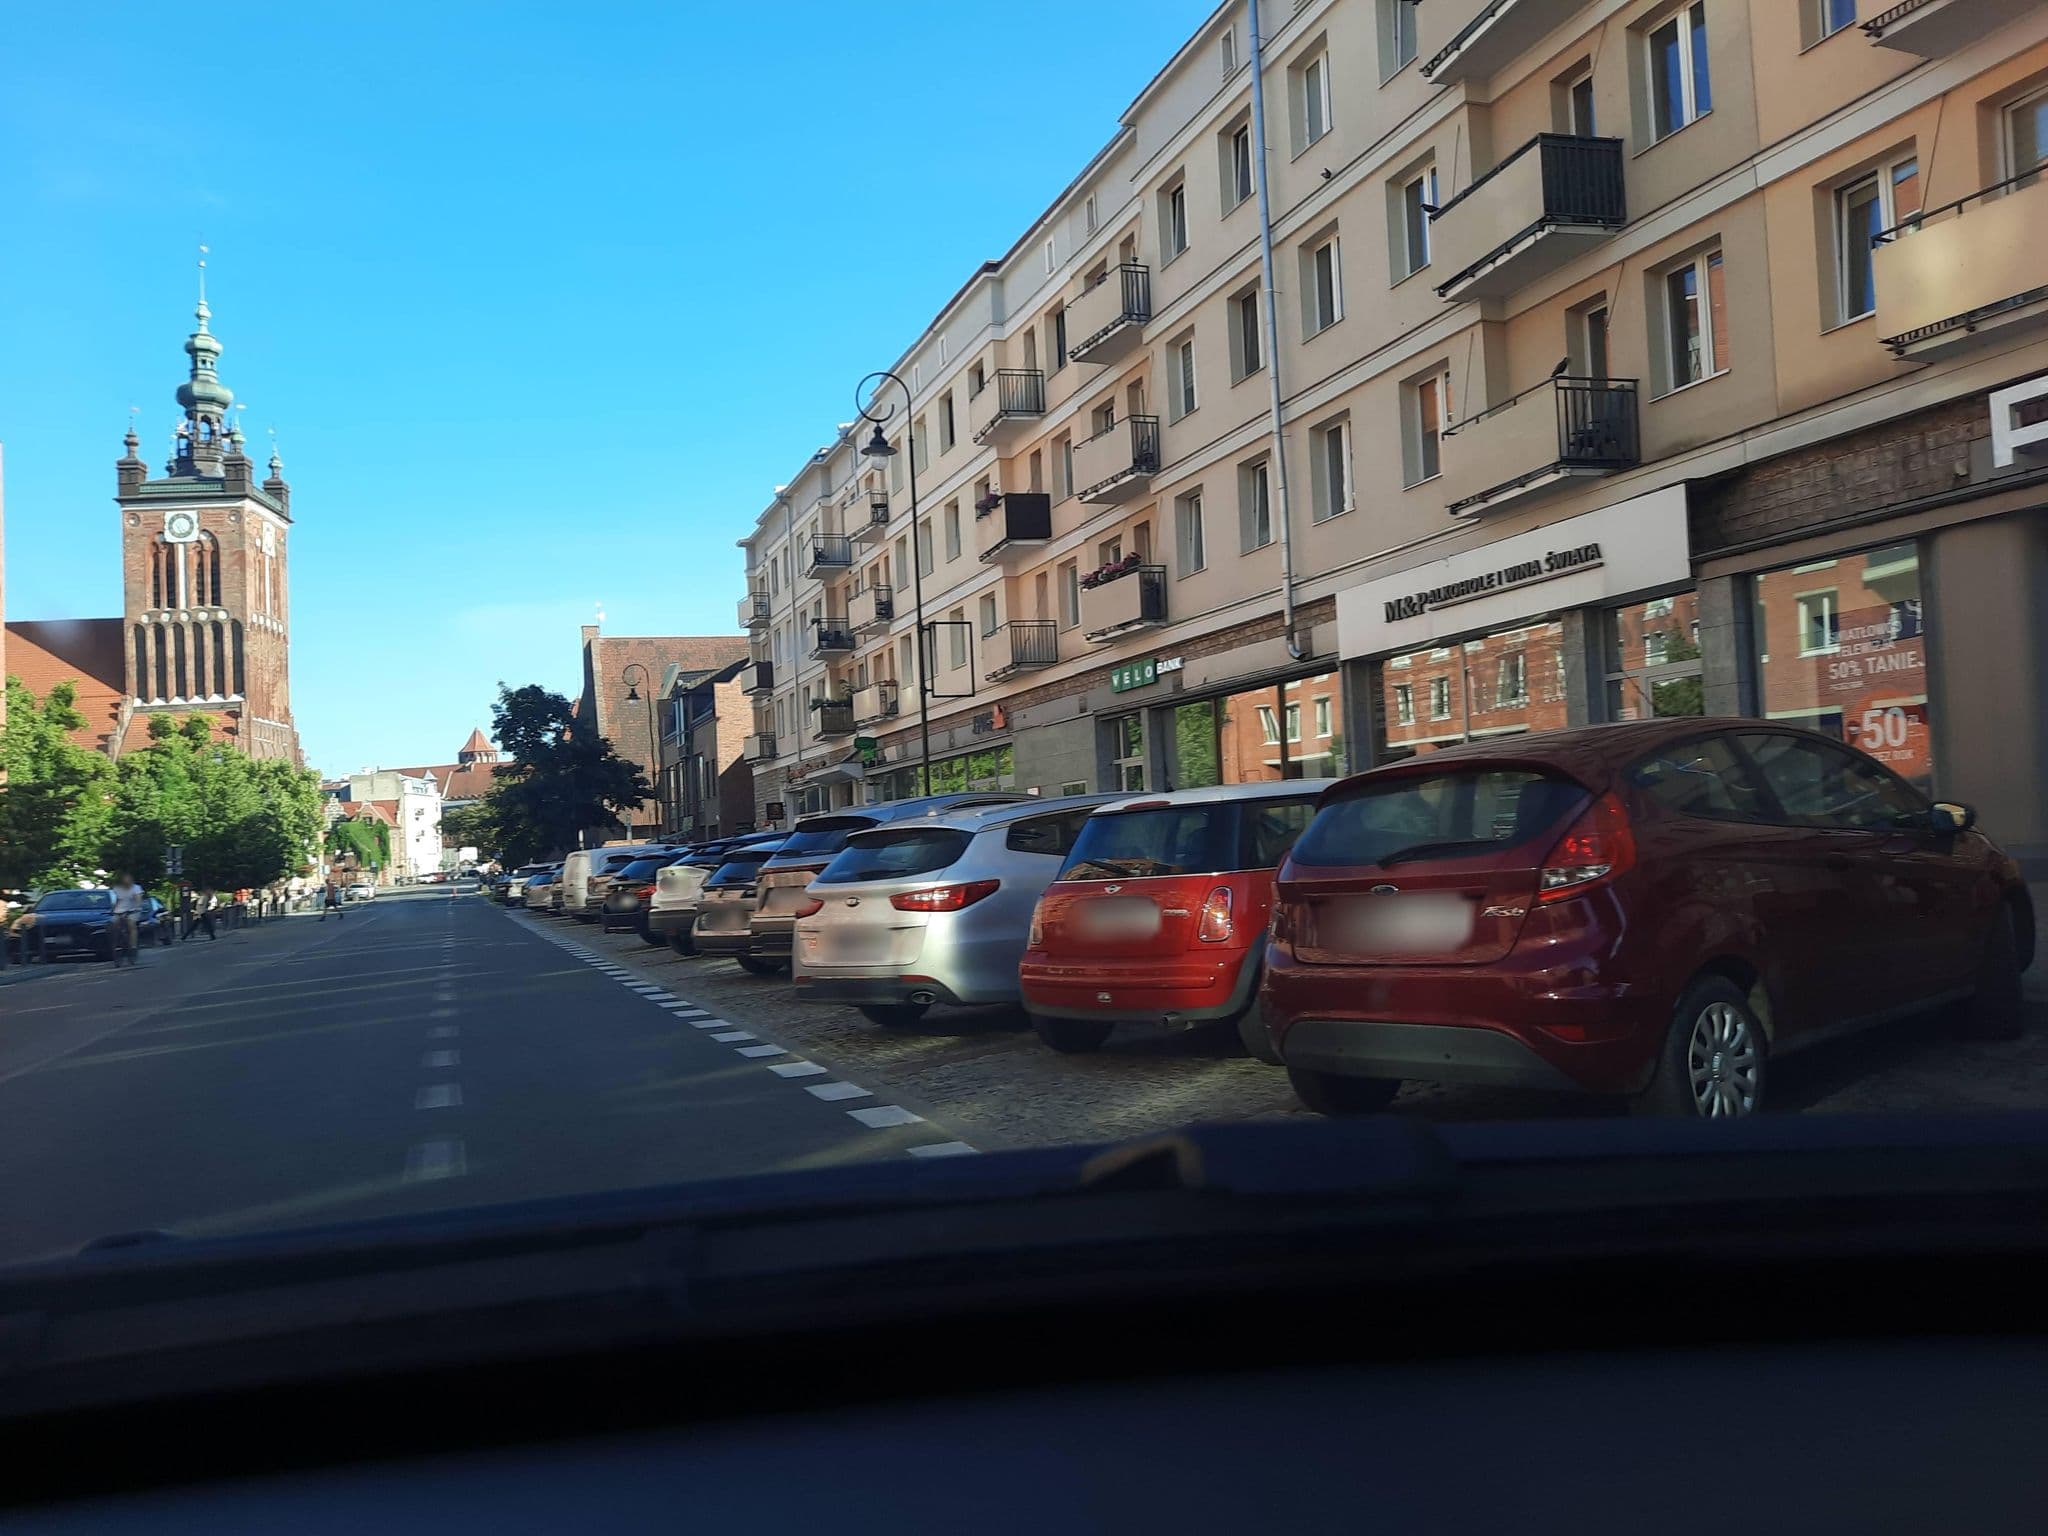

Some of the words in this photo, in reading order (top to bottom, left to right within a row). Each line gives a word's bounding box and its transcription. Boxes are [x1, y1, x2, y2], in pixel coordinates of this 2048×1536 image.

[1383, 593, 1427, 623] M&P
[1426, 573, 1496, 604] ALKOHOLE
[1497, 570, 1503, 585] I
[1503, 560, 1543, 583] WINA
[1544, 543, 1603, 572] ŚWIATA
[1112, 665, 1153, 687] VELO
